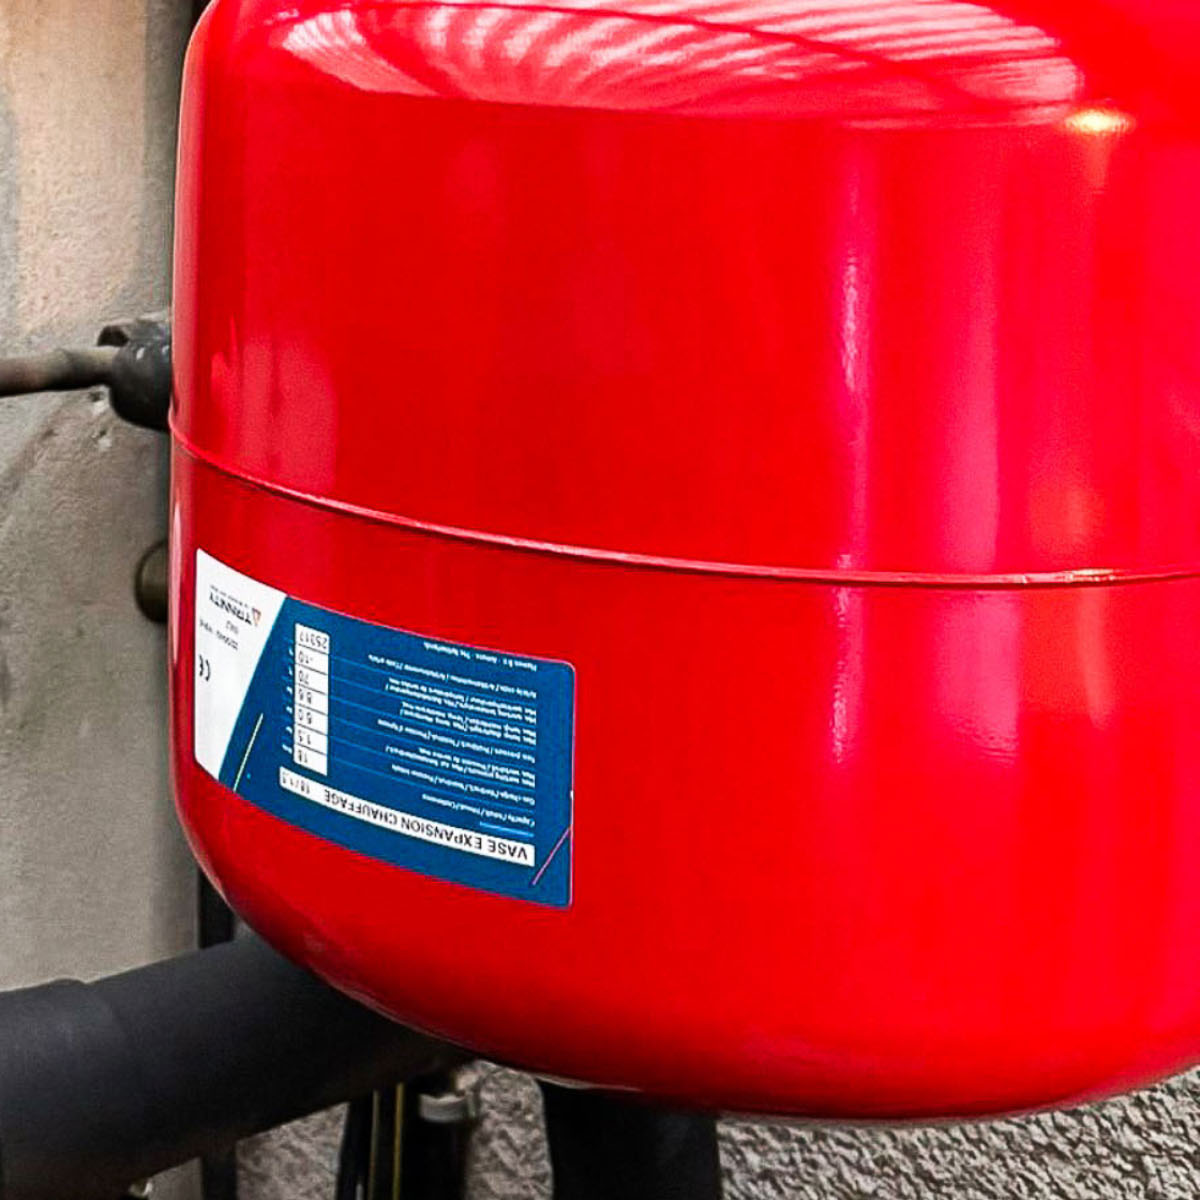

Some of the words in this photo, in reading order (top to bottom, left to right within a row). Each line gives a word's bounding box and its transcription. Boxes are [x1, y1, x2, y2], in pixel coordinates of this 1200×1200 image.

[323, 789, 398, 825] CHAUFFAGE
[400, 817, 482, 850] EXPANSION
[487, 839, 528, 860] VASE
